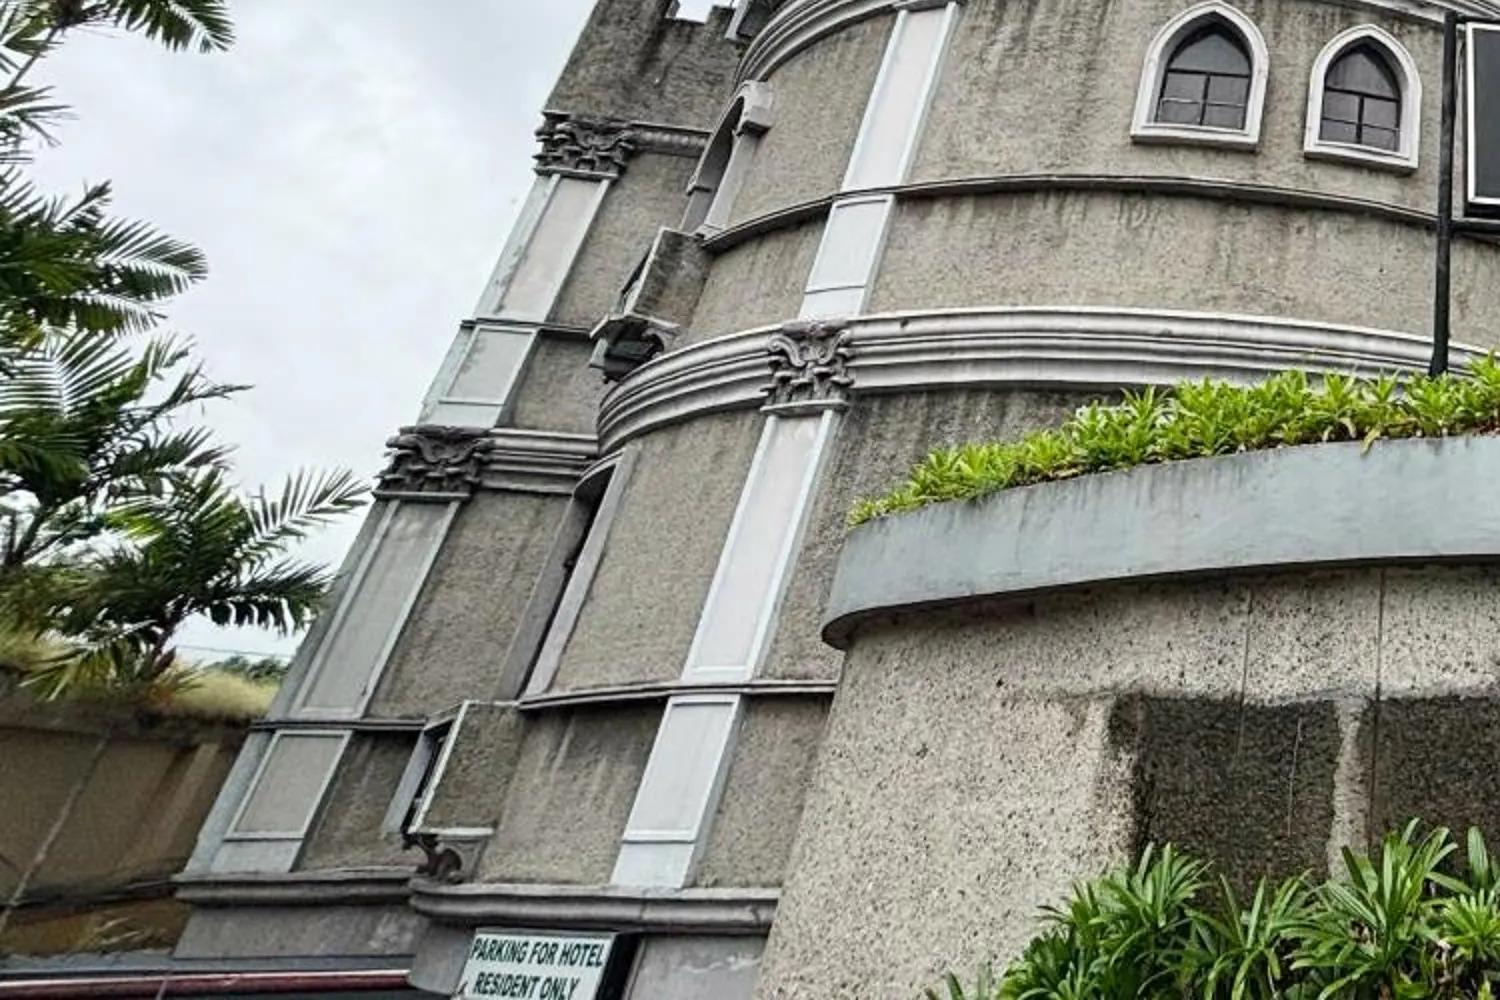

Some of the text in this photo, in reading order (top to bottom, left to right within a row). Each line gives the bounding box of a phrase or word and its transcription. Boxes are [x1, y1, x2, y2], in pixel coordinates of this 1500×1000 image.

[471, 938, 605, 967] PARKING FOR HOTEL
[473, 971, 581, 1000] RESIDENT ONLY
